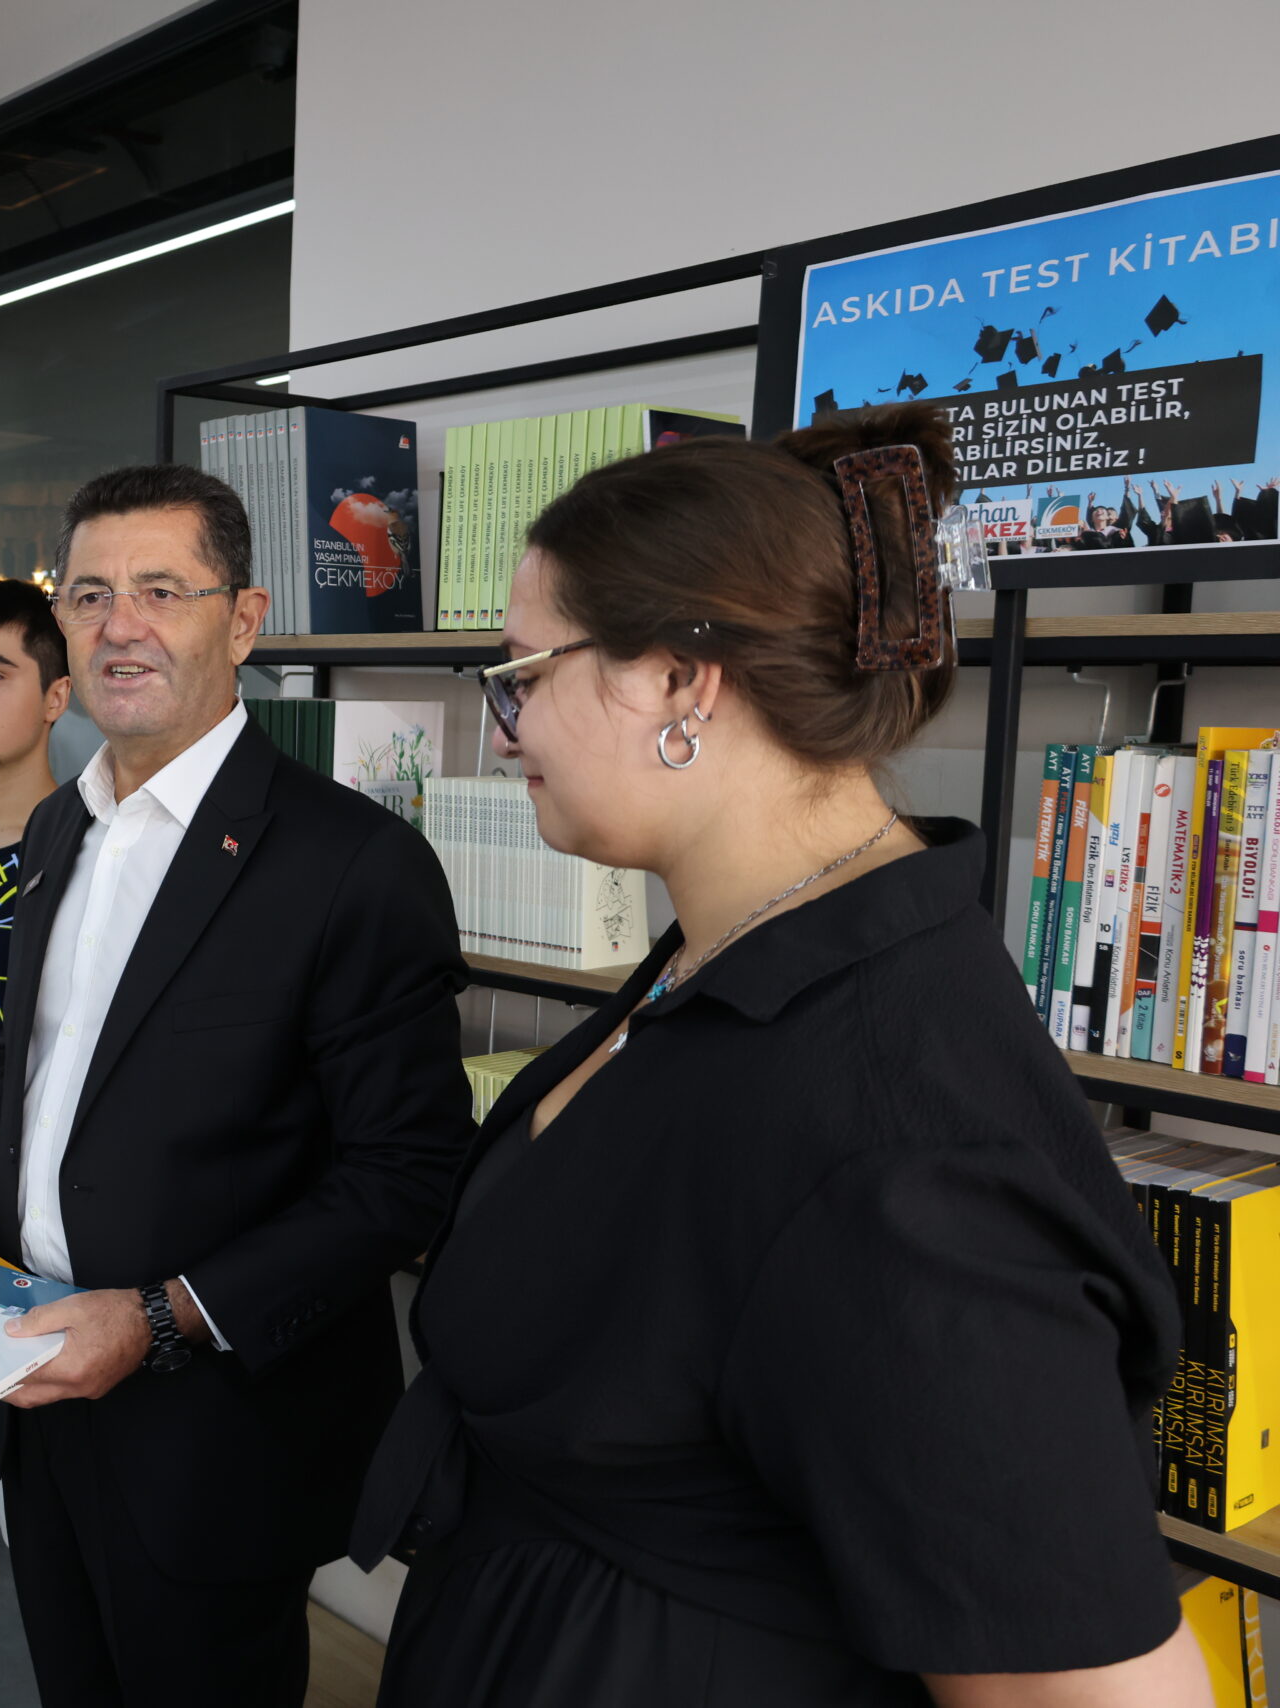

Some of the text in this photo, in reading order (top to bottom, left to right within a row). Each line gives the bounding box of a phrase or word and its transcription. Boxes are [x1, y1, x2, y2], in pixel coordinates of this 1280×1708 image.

[812, 218, 1279, 329] ASKIDA TEST KİTABI
[946, 378, 1184, 423] TA BULUNAN TEST
[951, 398, 1190, 442] RI SİZİN OLABİLİR,
[952, 429, 1106, 462] ABİLİRSİNİZ.
[955, 462, 1017, 482] RILAR
[1026, 447, 1128, 476] DİLERİZ
[968, 504, 1018, 523] rhan
[984, 522, 1027, 538] KEZ
[314, 538, 365, 552] İSTANBUL'UN
[314, 552, 369, 564] YAŞAM PINARI
[314, 567, 404, 590] ÇEKMEKÖY
[1061, 767, 1072, 788] AYT
[1230, 761, 1240, 781] Türk
[1109, 822, 1120, 846] Fizik
[1027, 751, 1058, 958] AYT MATEMATİK SORU BANKASI
[1054, 839, 1064, 858] Soru
[1122, 847, 1131, 863] LYS
[1050, 860, 1061, 893] Bankası
[1083, 835, 1100, 923] Fizik Ders Anlatım Föyü
[1056, 753, 1091, 1038] AYT FİZİK SORU BANKASI SUPARA
[1145, 885, 1159, 913] FİZİK
[1100, 923, 1111, 933] 10
[1165, 948, 1174, 966] Konu
[1161, 966, 1171, 1003] Anlatımlı
[1234, 950, 1246, 1010] soru bankası
